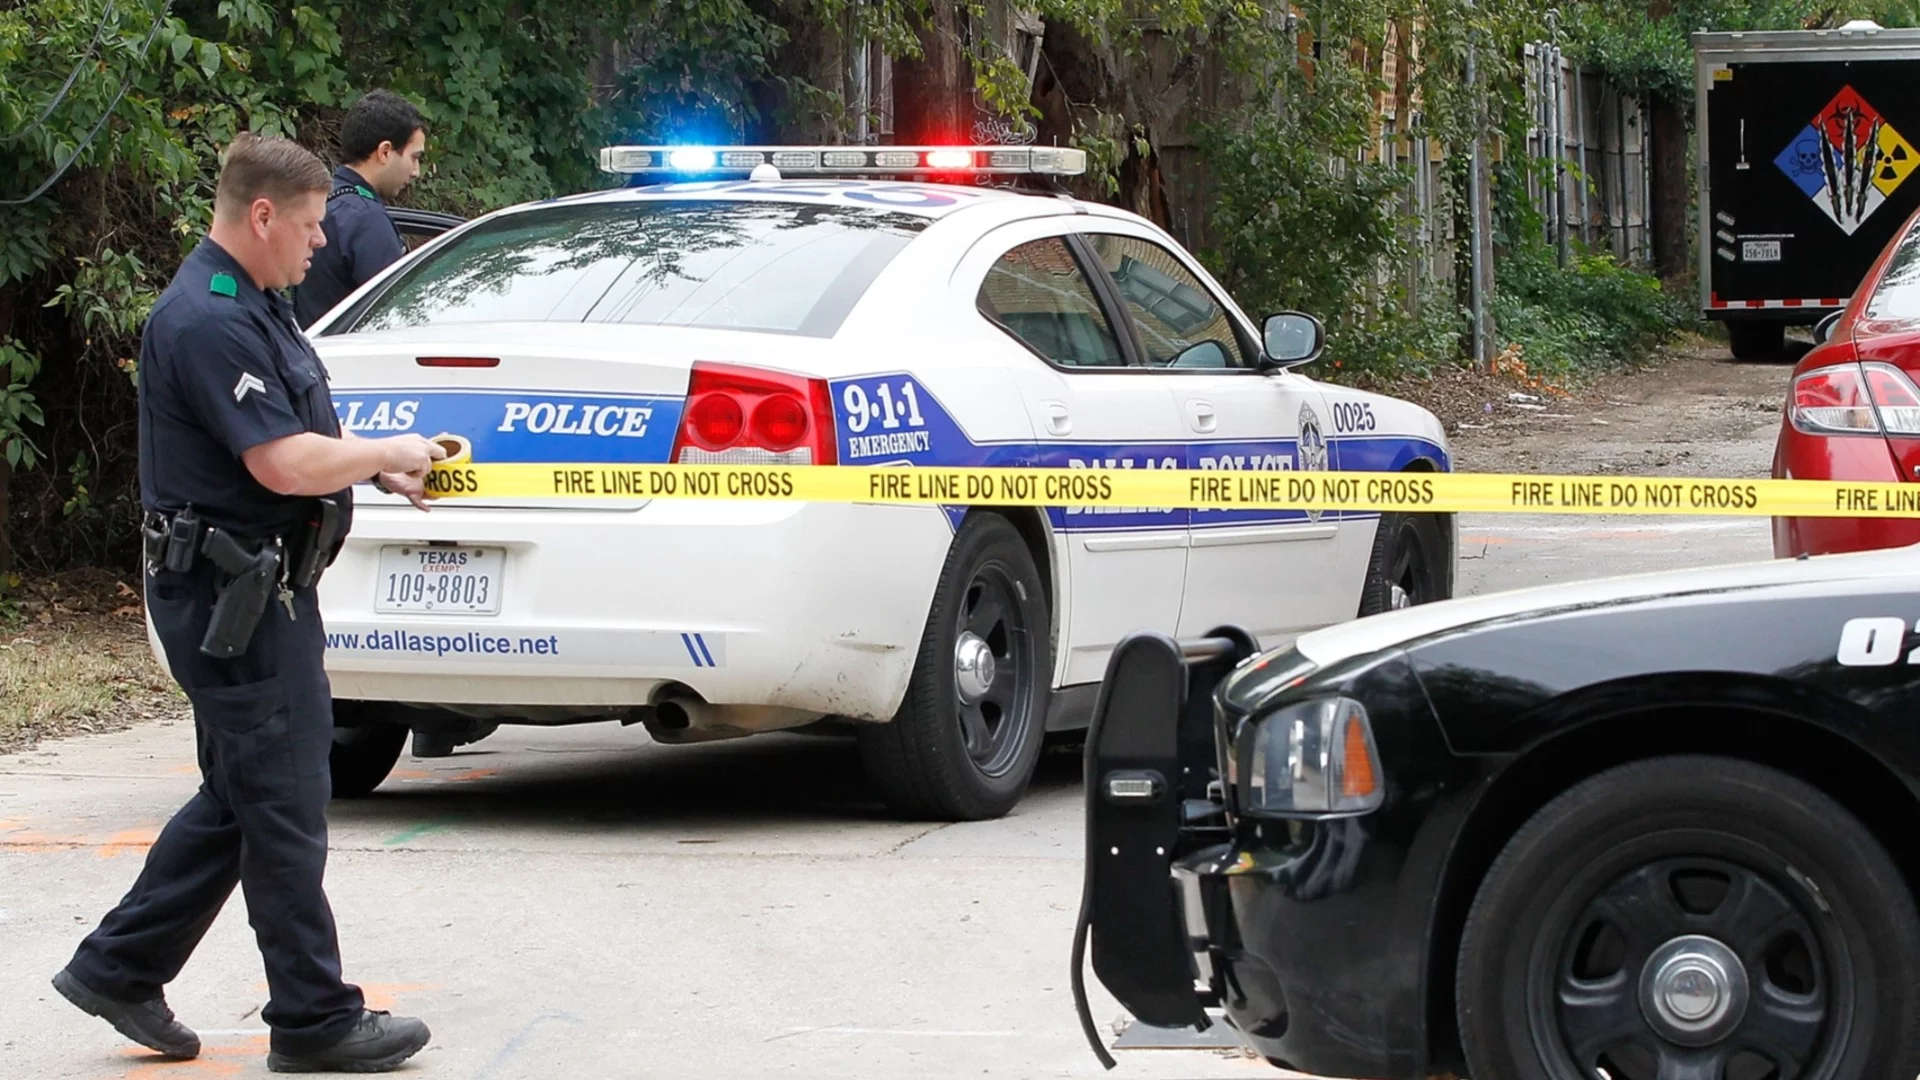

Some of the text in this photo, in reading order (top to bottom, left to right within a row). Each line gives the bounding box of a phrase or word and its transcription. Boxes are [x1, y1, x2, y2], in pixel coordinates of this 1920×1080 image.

[498, 403, 653, 437] POLICE
[1334, 402, 1376, 432] 0025
[848, 431, 930, 458] EMERGENCY
[554, 471, 793, 497] FIRE LINE DO NOT CROSS
[870, 474, 1112, 500] FIRE LINE DO NOT CROSS
[1190, 477, 1434, 504] FIRE LINE DO NOT CROSS
[1512, 482, 1757, 509] FIRE LINE DO NOT CROSS
[1836, 489, 1878, 511] FIRE
[418, 551, 468, 565] TEXAS
[422, 564, 461, 573] EXEMPT
